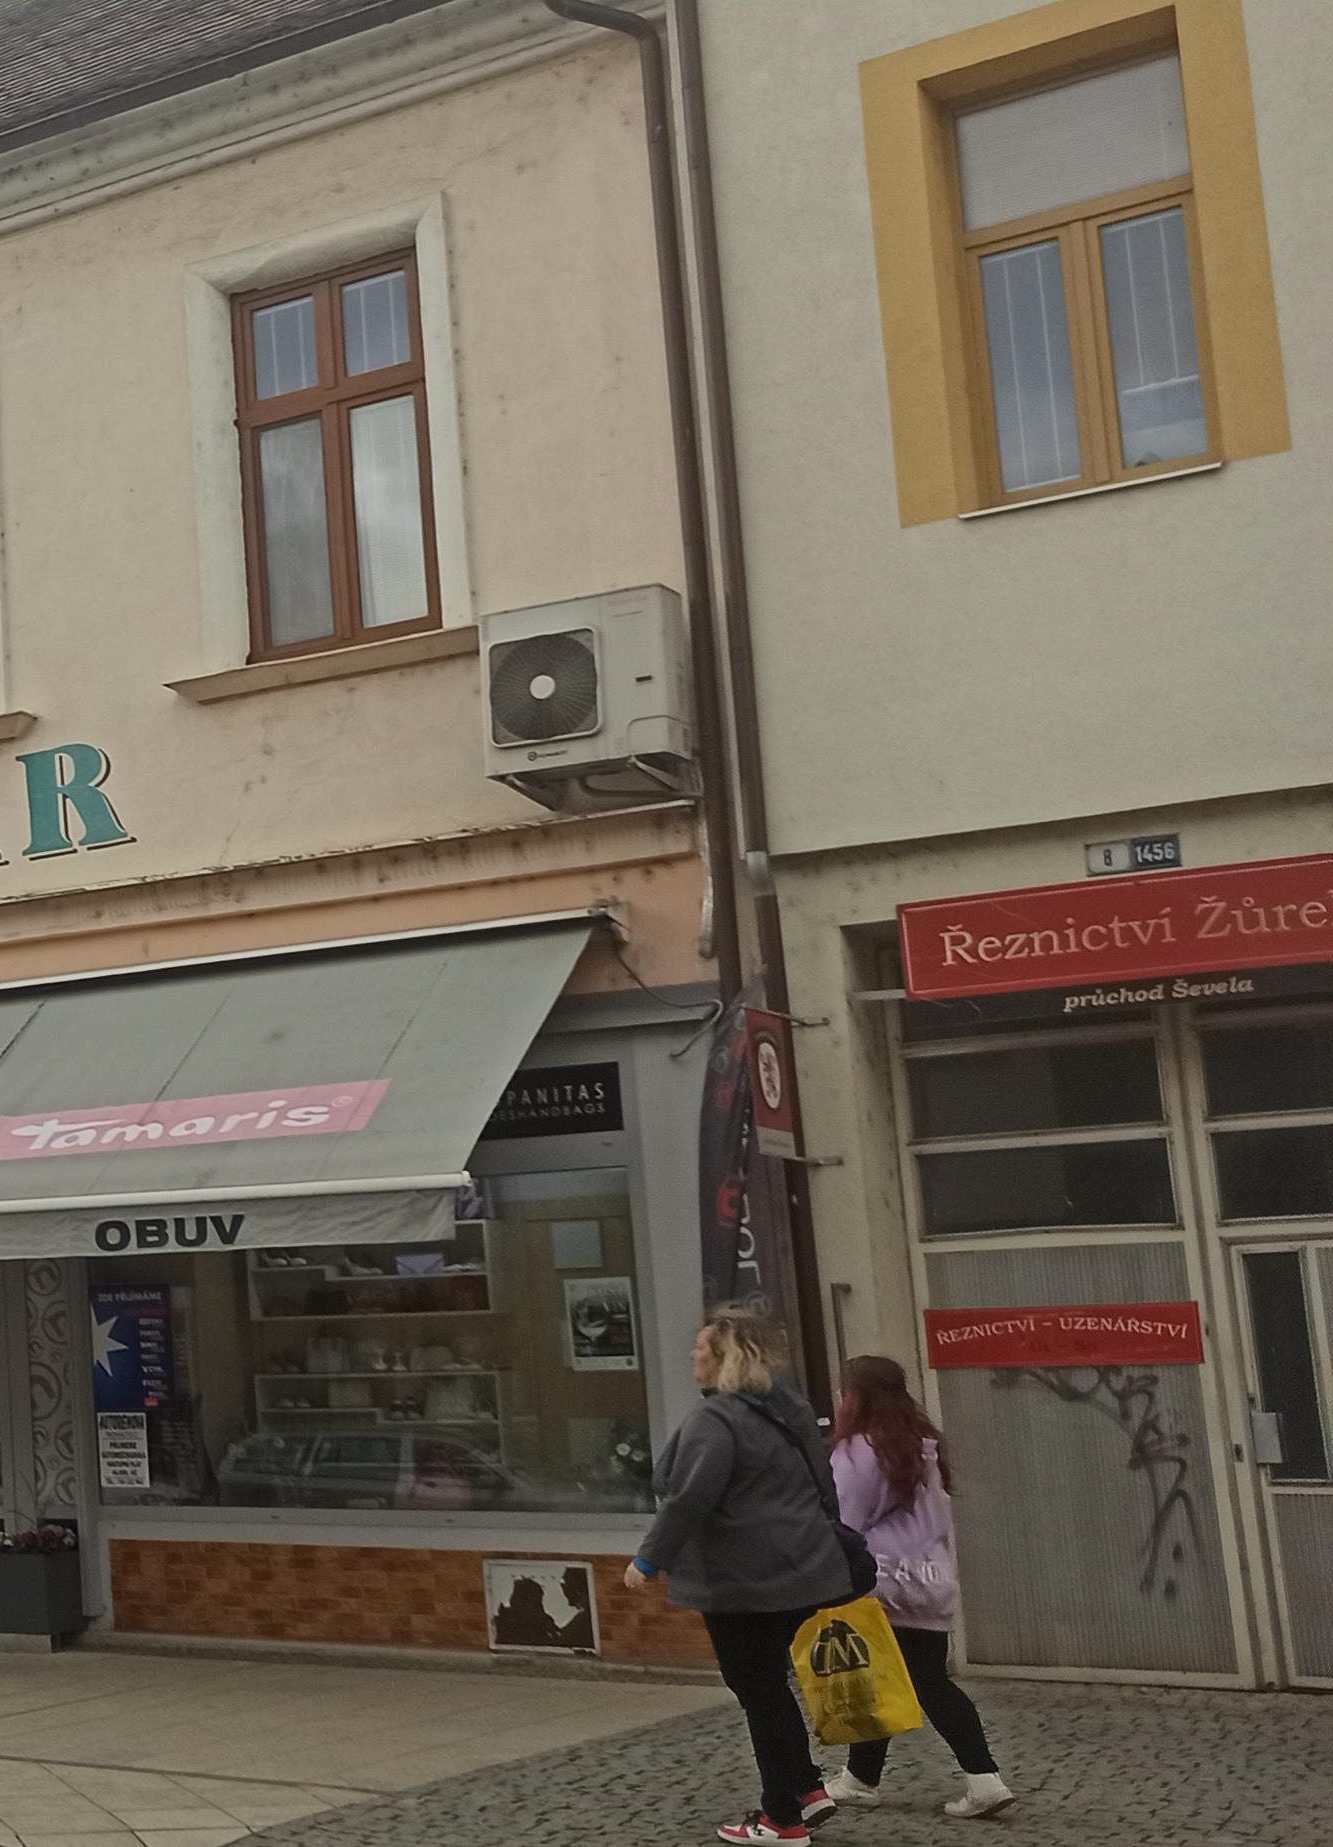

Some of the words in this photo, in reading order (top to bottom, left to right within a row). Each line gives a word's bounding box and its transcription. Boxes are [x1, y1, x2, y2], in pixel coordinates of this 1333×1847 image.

[1135, 841, 1176, 864] 1456
[939, 908, 1177, 967] Řeznictví
[1063, 983, 1164, 1014] průchod
[1171, 976, 1255, 1000] Ševela
[506, 1082, 605, 1105] PANITAS
[94, 1213, 247, 1252] OBUV
[1059, 1316, 1188, 1340] UZENÁŘSTVÍ
